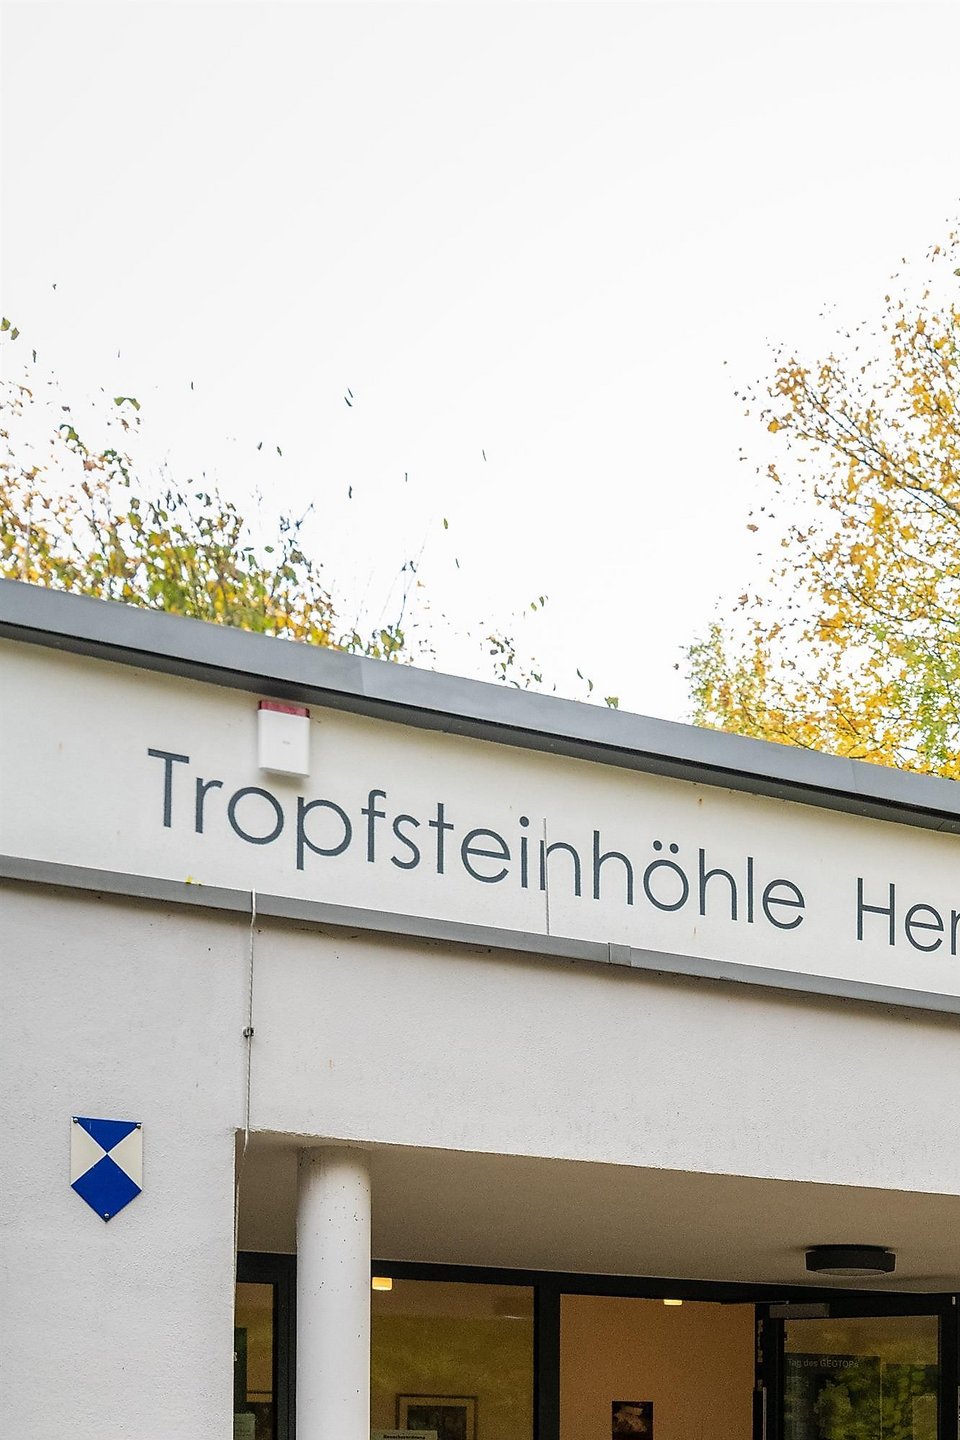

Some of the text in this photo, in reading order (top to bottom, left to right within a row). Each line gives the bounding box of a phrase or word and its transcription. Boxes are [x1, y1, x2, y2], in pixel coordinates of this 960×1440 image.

[147, 748, 806, 930] Tropfsteinhöhle
[788, 1358, 802, 1369] Tag
[803, 1358, 819, 1368] des
